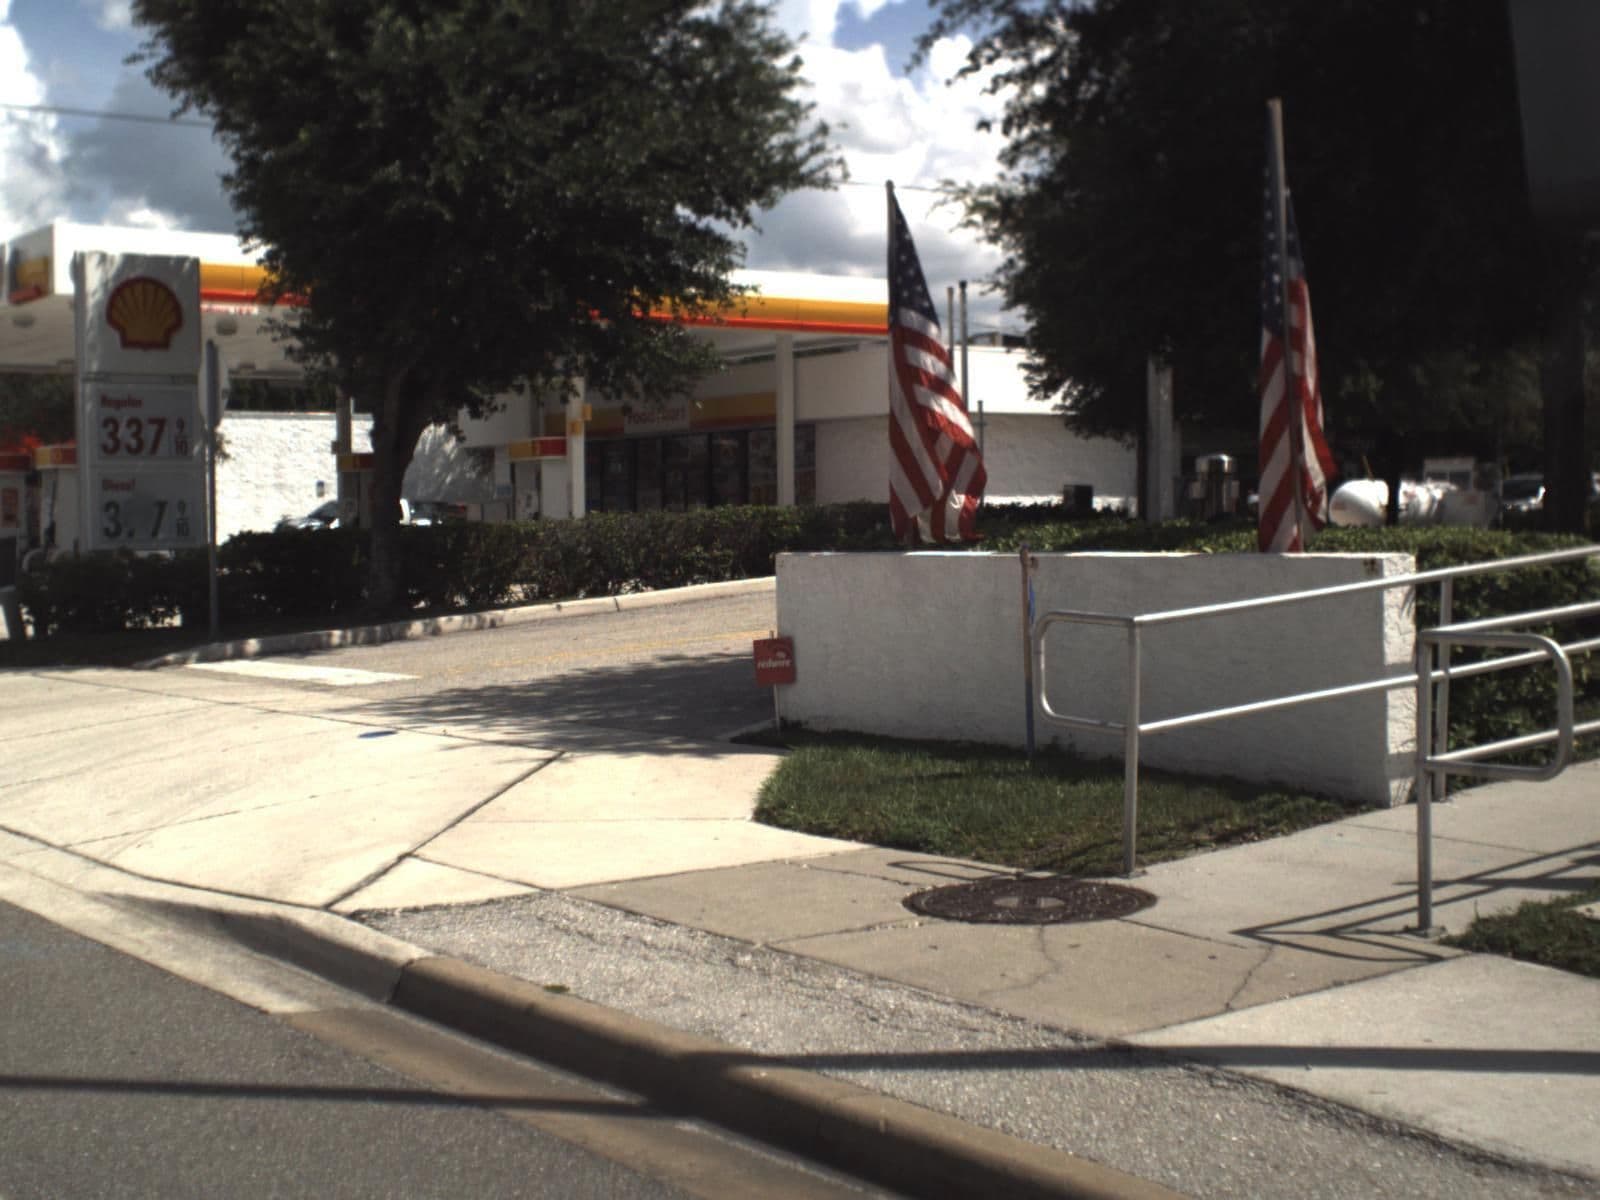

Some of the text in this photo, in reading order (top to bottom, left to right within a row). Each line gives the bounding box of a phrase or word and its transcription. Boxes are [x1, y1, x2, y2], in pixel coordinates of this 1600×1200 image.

[100, 394, 142, 410] Regular
[101, 416, 168, 457] 337
[102, 478, 136, 491] Diesel
